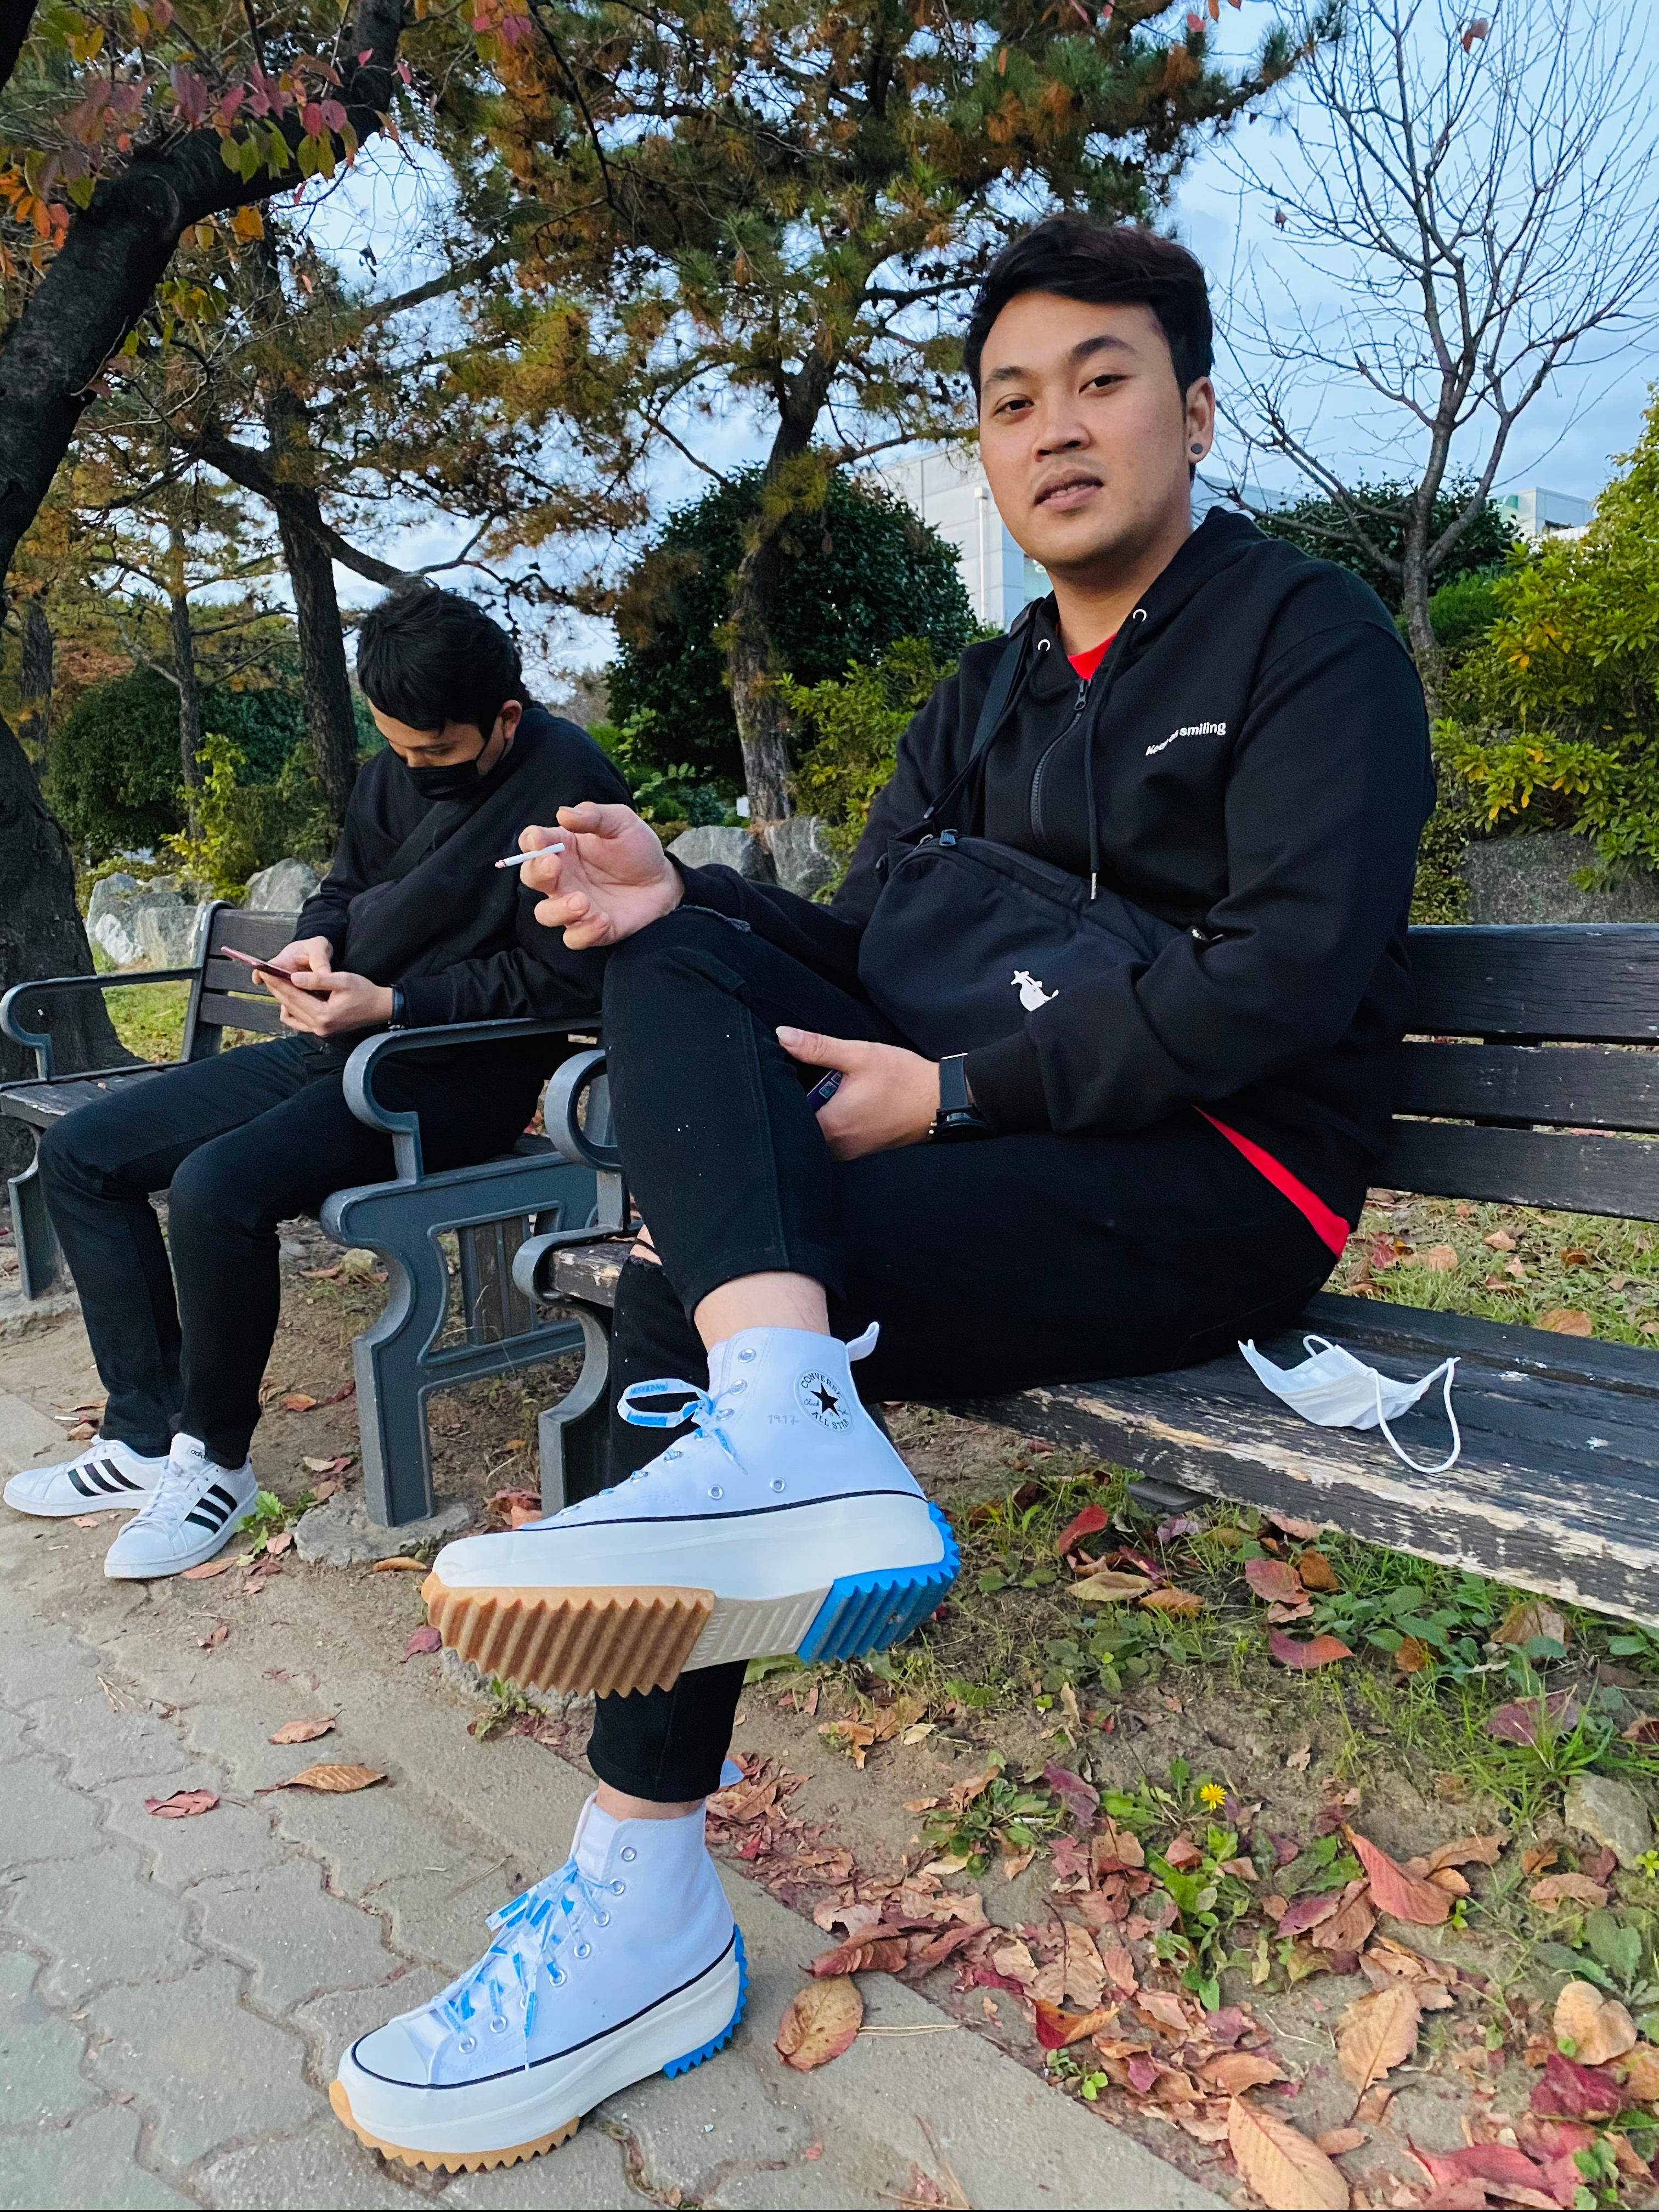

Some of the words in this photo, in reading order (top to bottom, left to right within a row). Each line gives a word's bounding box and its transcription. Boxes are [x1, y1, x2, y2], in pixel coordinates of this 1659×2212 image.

[1180, 721, 1226, 736] smiling
[801, 1372, 842, 1398] CONVERSE
[811, 1410, 829, 1426] ALL
[832, 1418, 849, 1430] STAR
